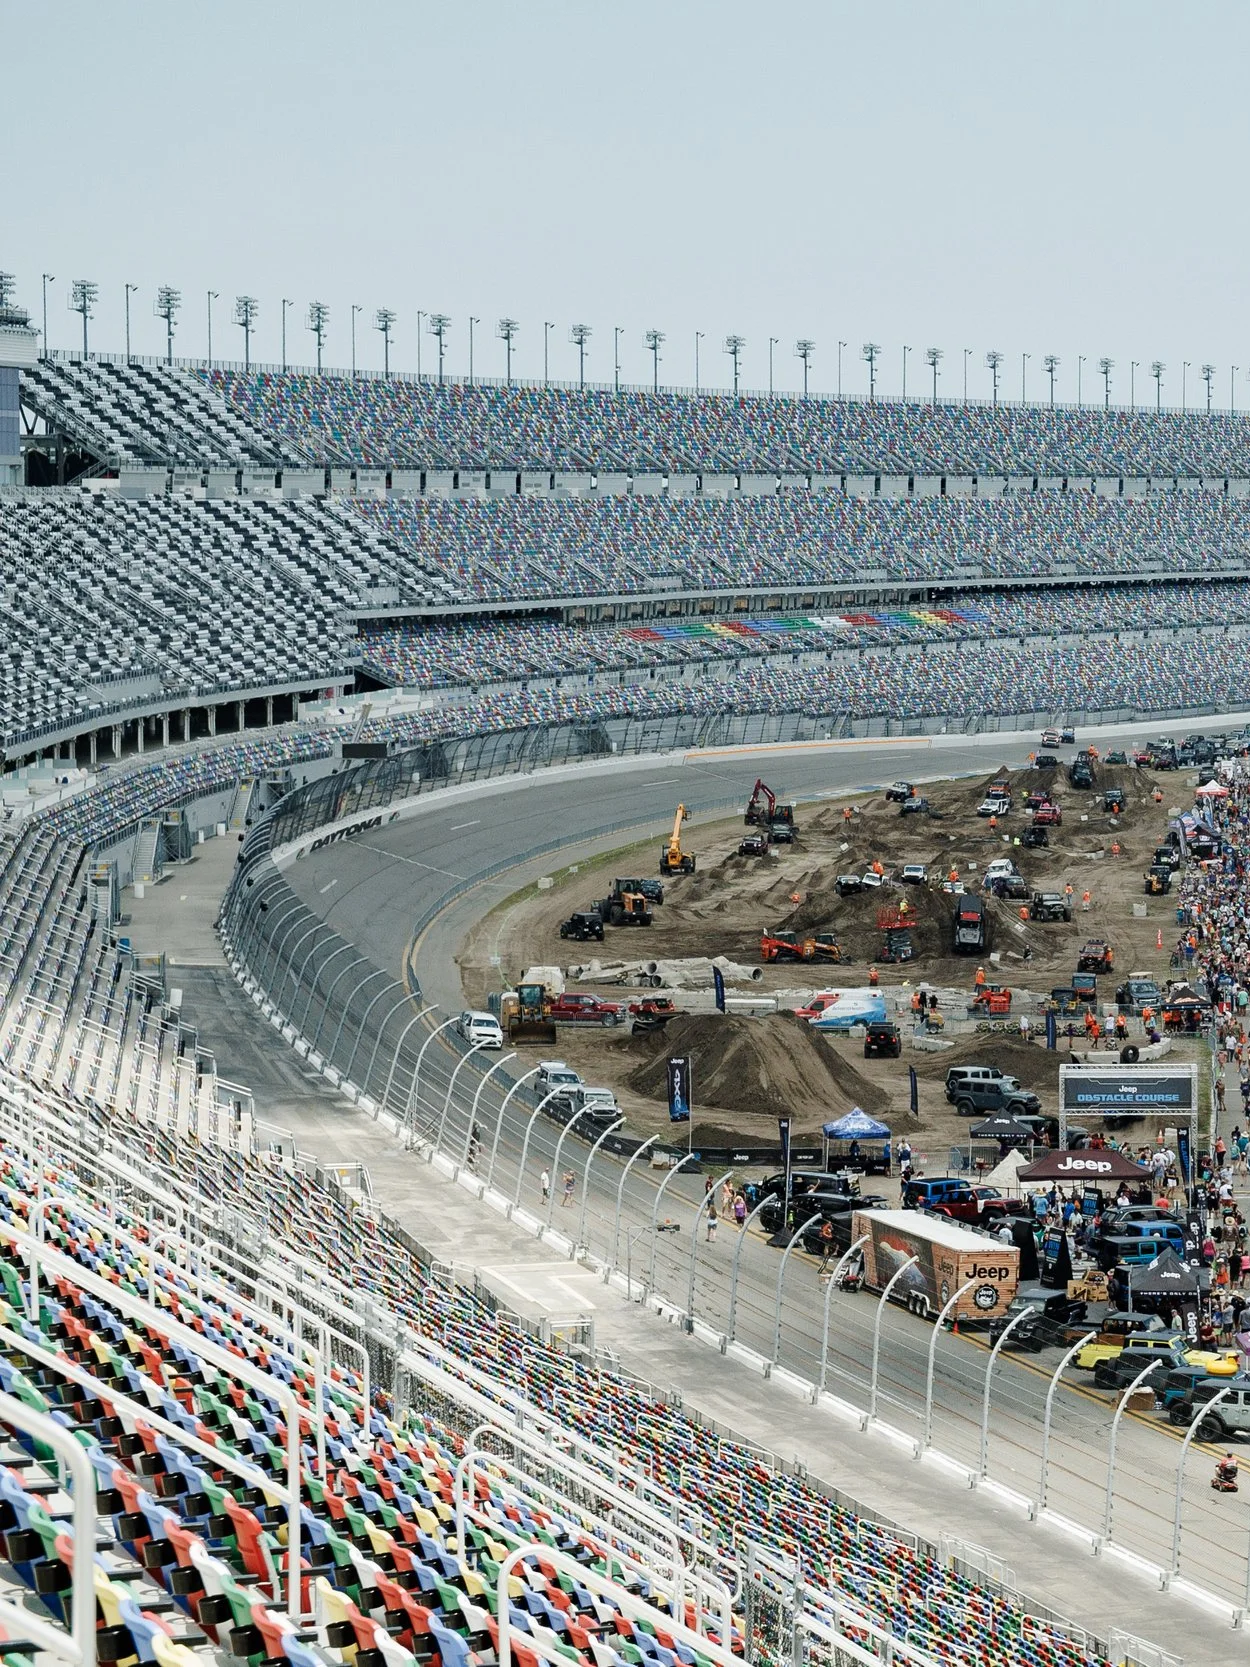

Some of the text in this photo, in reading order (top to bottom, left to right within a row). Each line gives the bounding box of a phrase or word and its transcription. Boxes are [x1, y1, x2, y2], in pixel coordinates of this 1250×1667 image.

[1118, 1085, 1138, 1093] Jeep
[1077, 1094, 1134, 1102] OBSTACLE
[1058, 1157, 1112, 1172] Jeep
[965, 1263, 1009, 1281] Jeep
[1187, 1311, 1198, 1343] Jeep
